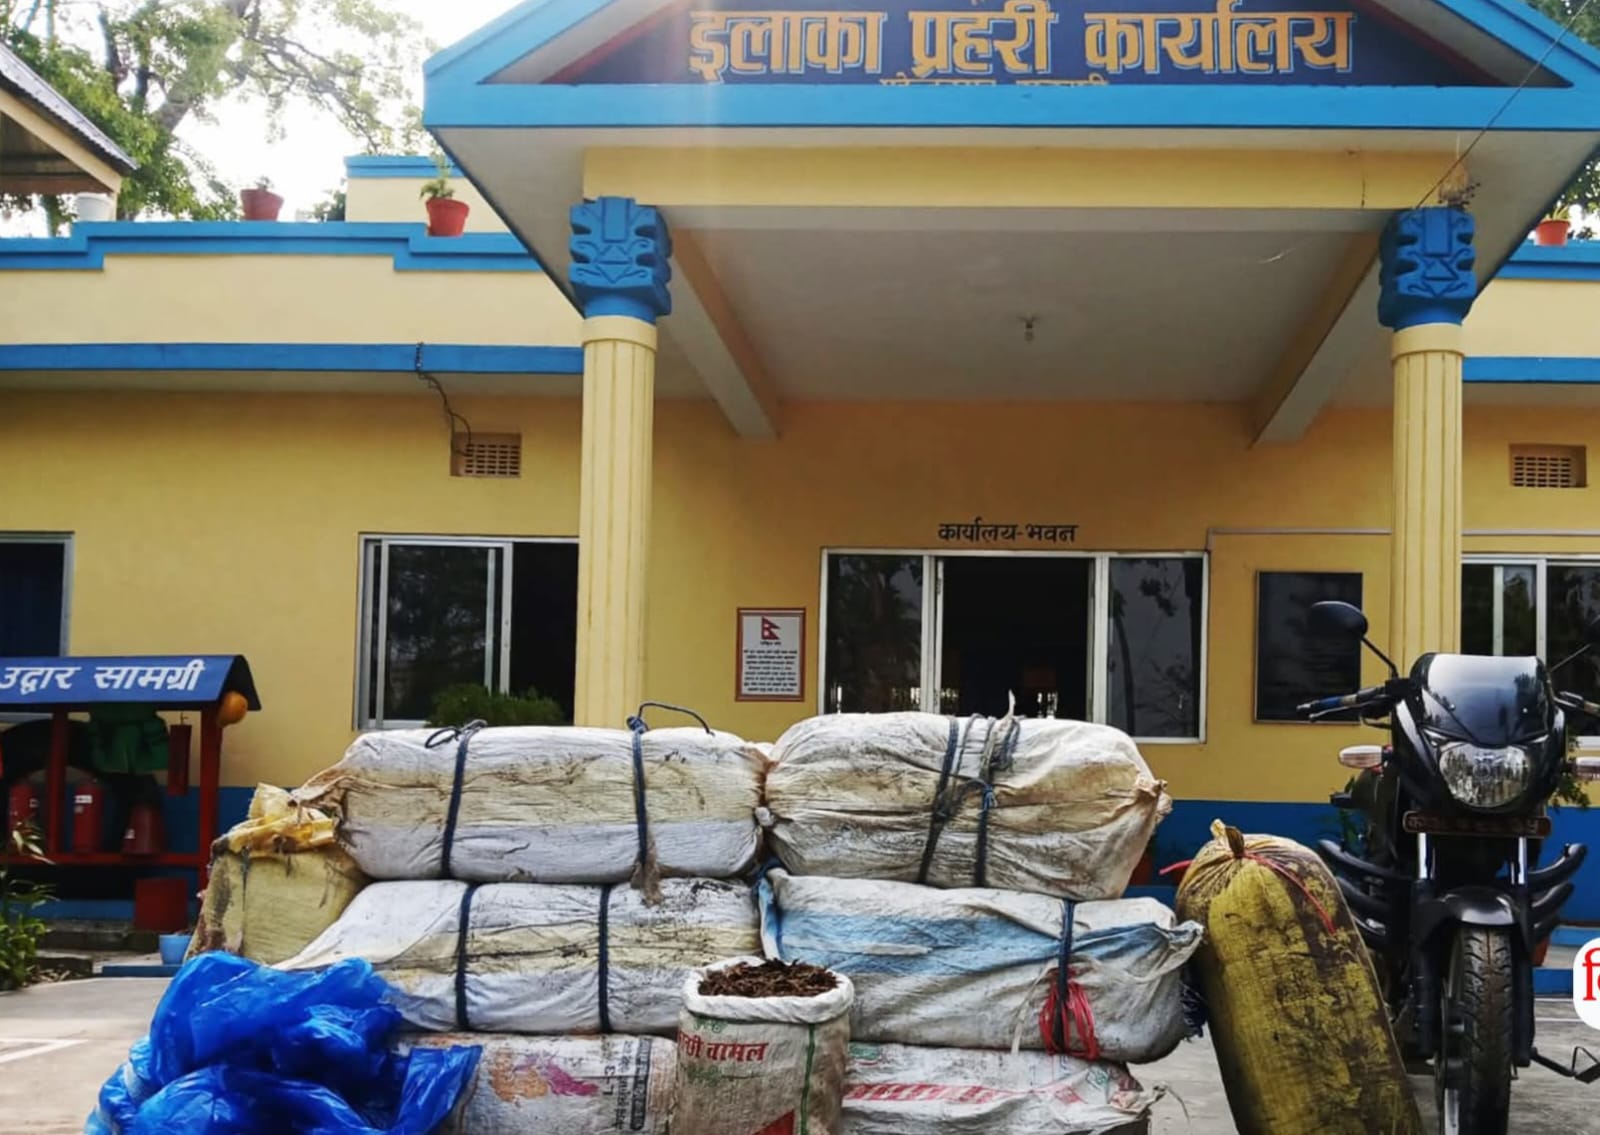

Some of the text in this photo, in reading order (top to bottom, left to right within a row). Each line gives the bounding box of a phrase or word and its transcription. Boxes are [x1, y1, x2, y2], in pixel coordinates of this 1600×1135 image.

[689, 0, 1356, 84] इलाका प्रहरी कार्यालय
[94, 659, 206, 691] सामग्री
